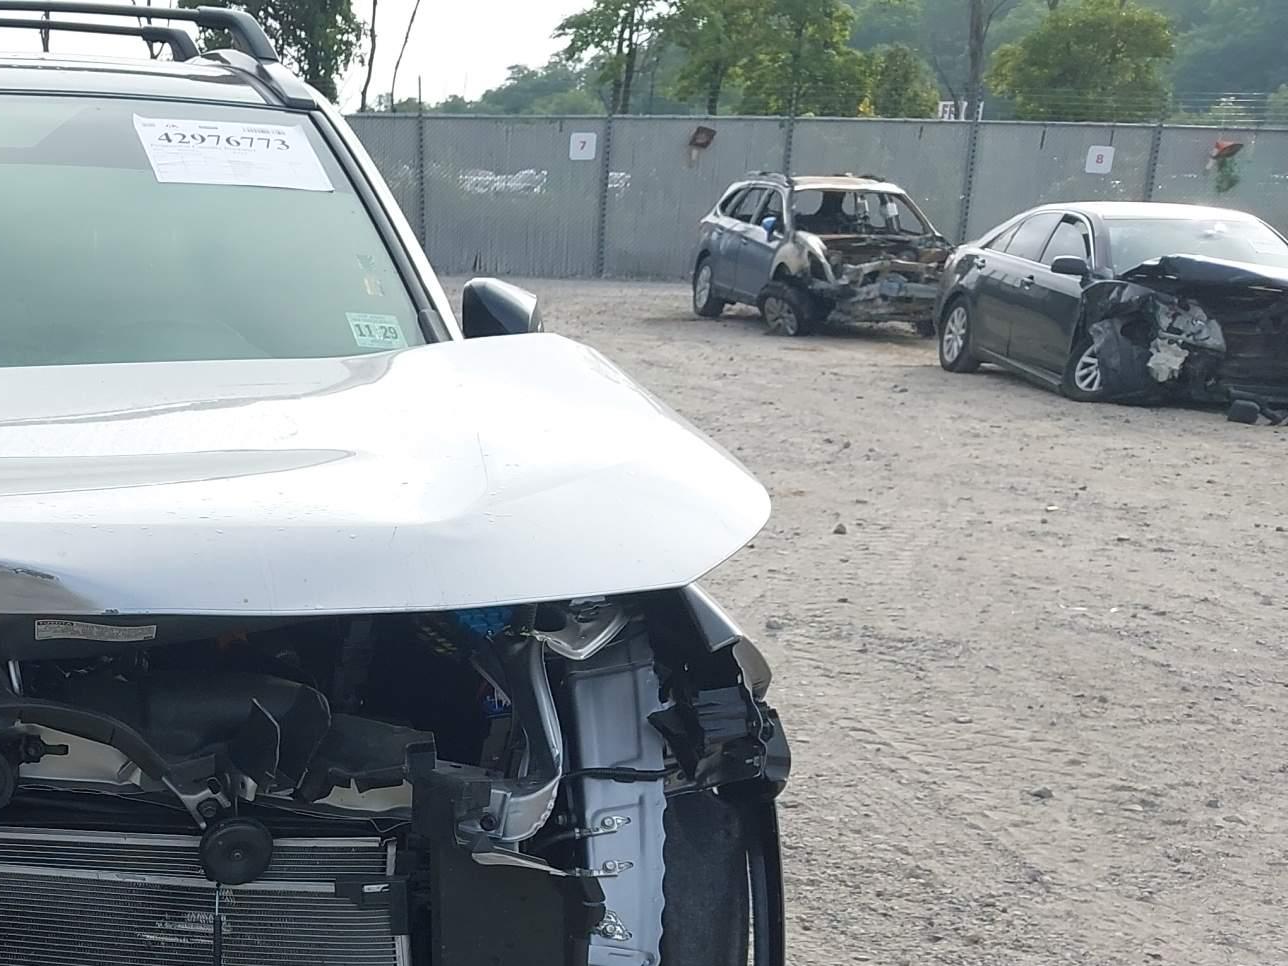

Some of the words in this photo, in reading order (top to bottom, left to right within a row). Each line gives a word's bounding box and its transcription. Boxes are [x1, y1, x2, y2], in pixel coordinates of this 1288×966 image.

[157, 132, 290, 151] 42976773
[579, 140, 587, 151] 7
[1095, 153, 1104, 165] 8
[354, 323, 376, 338] 11
[379, 325, 399, 340] 29
